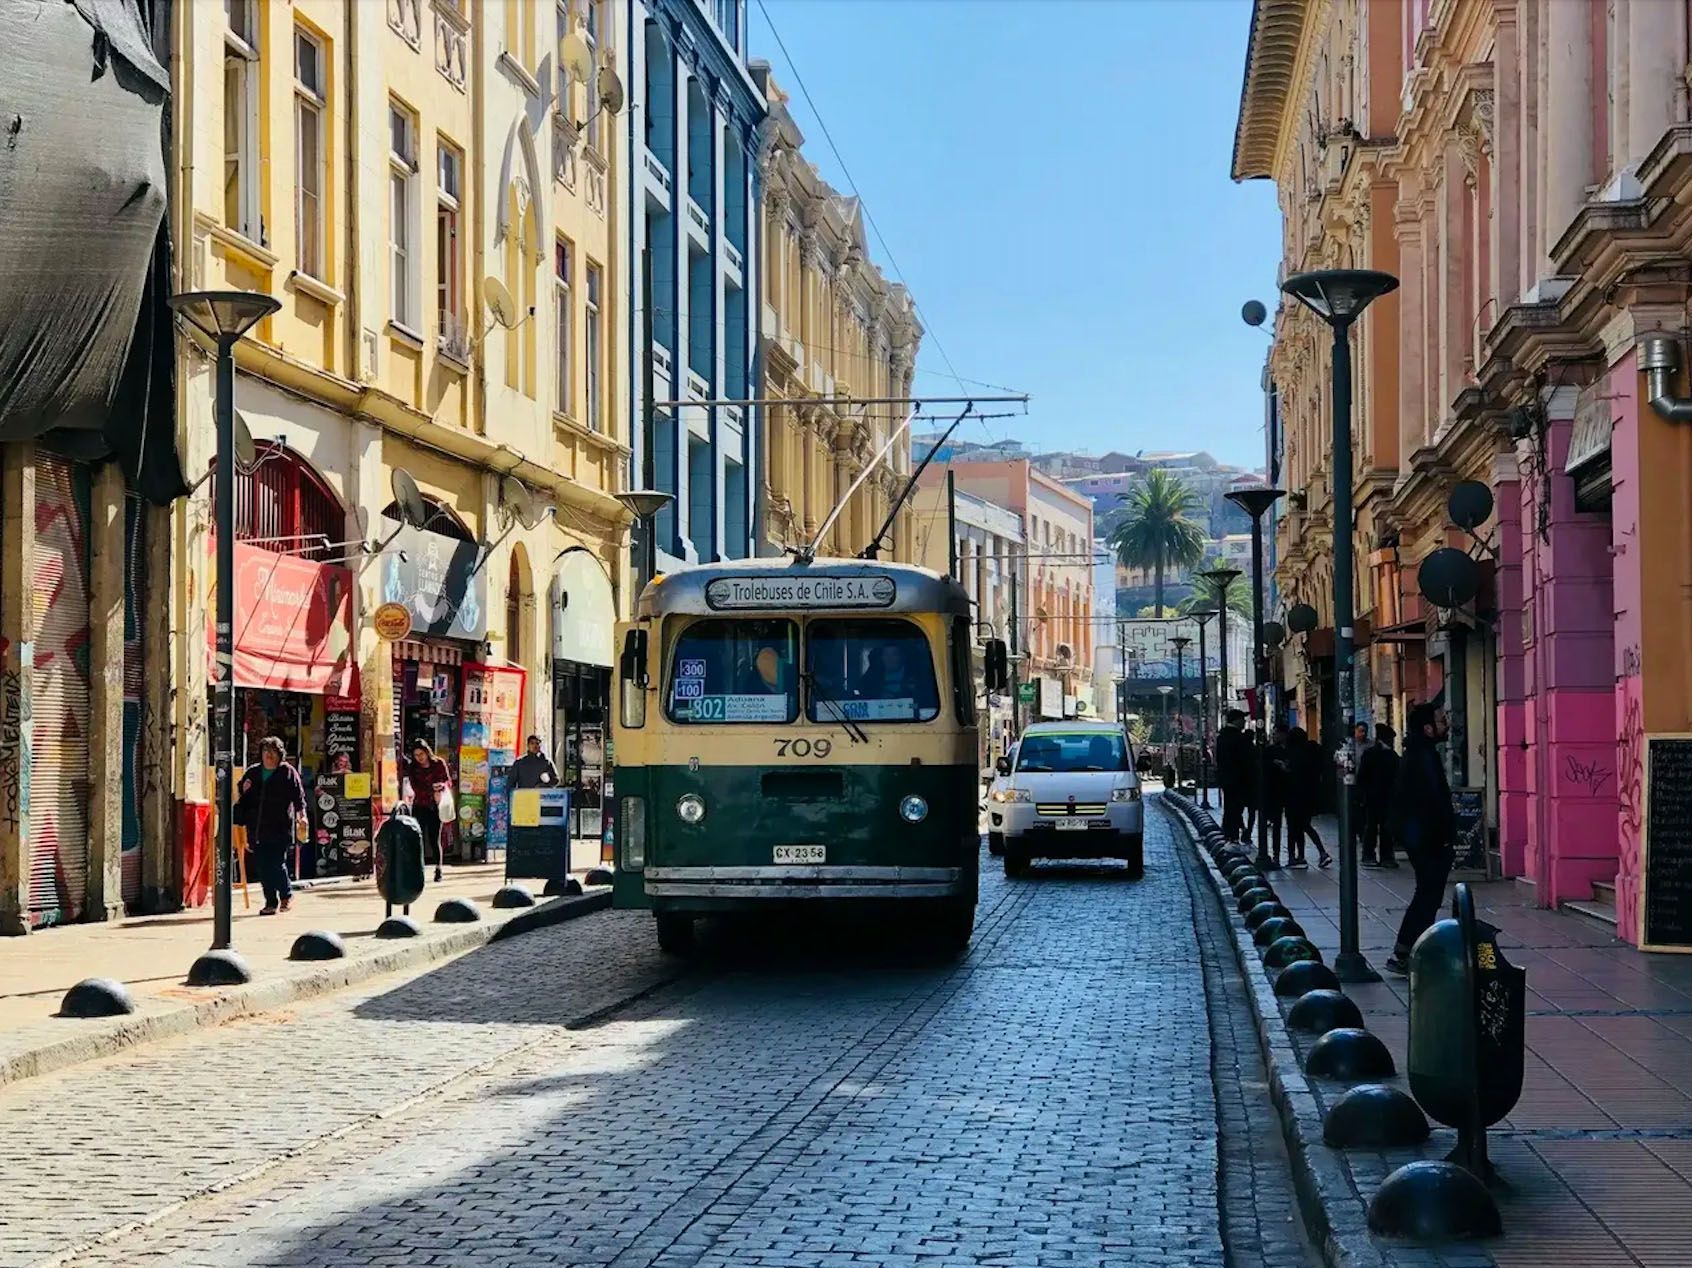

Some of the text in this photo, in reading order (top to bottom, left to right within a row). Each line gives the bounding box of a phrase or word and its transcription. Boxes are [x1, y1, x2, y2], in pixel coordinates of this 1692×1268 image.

[733, 583, 793, 600] Trolebuses
[797, 582, 811, 600] de
[847, 582, 869, 600] S.A.
[693, 699, 723, 718] 802
[773, 738, 832, 758] 709
